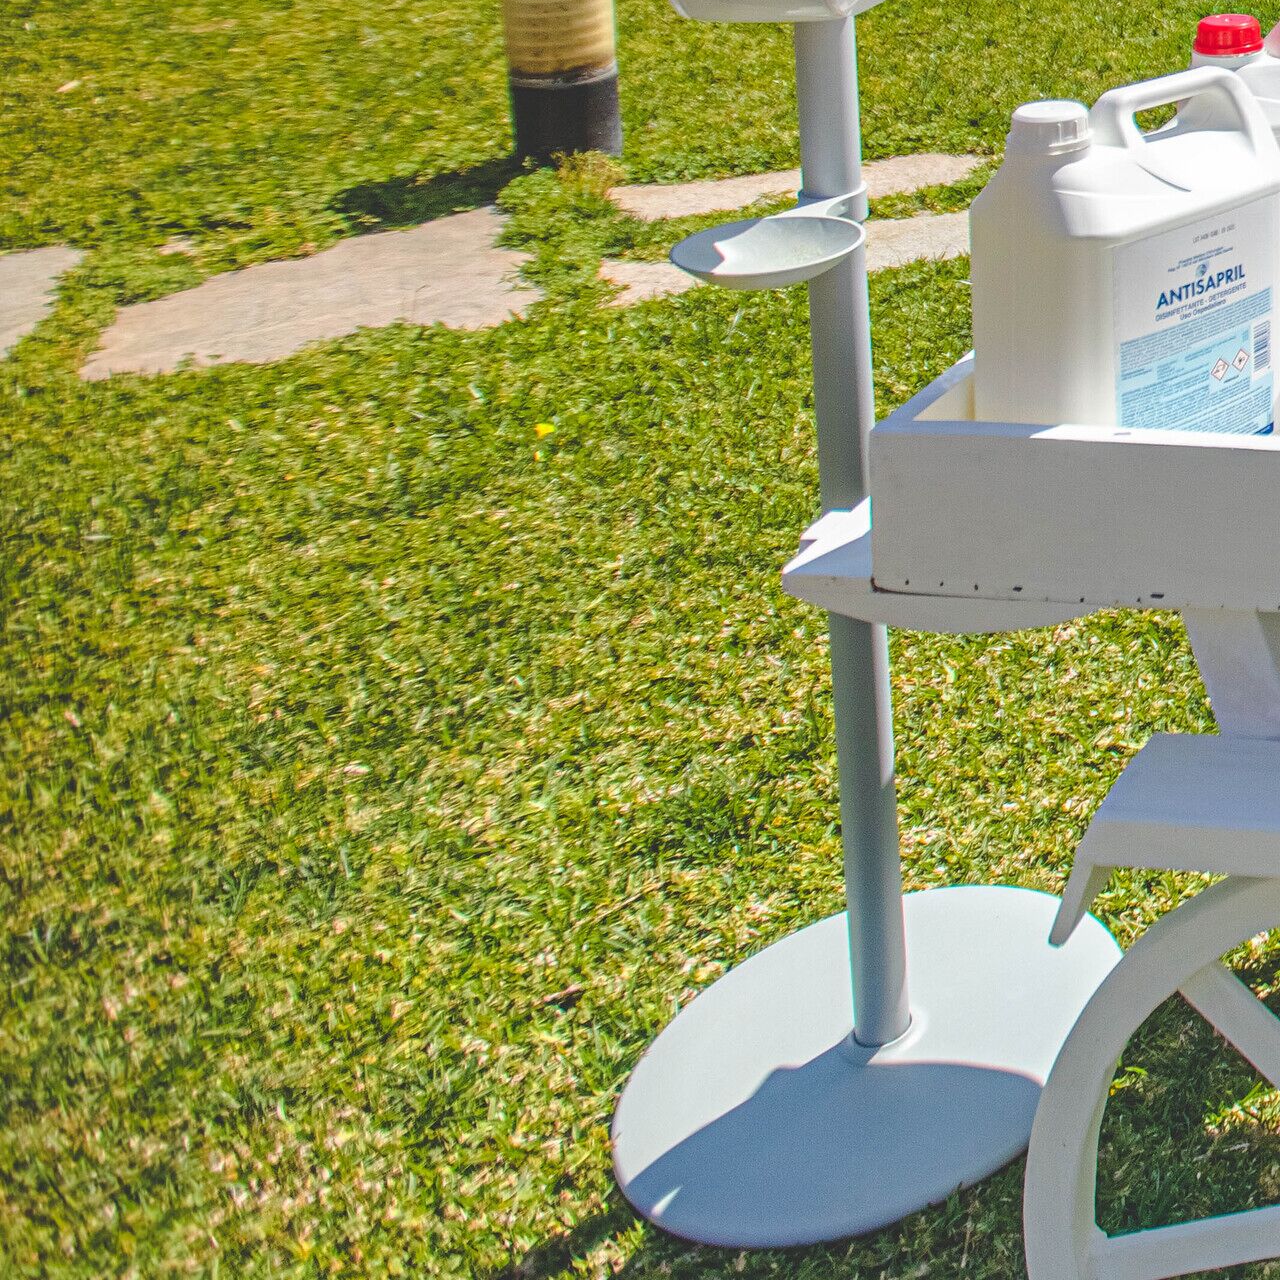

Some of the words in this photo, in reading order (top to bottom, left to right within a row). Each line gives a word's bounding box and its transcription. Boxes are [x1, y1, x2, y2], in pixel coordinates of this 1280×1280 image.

[1155, 298, 1205, 322] DISINFETTANTE
[1208, 281, 1247, 302] DETERGENTE
[1156, 264, 1246, 310] ANTISAPRIL
[1180, 312, 1192, 321] Uso
[1192, 299, 1227, 318] Ospedaliero
